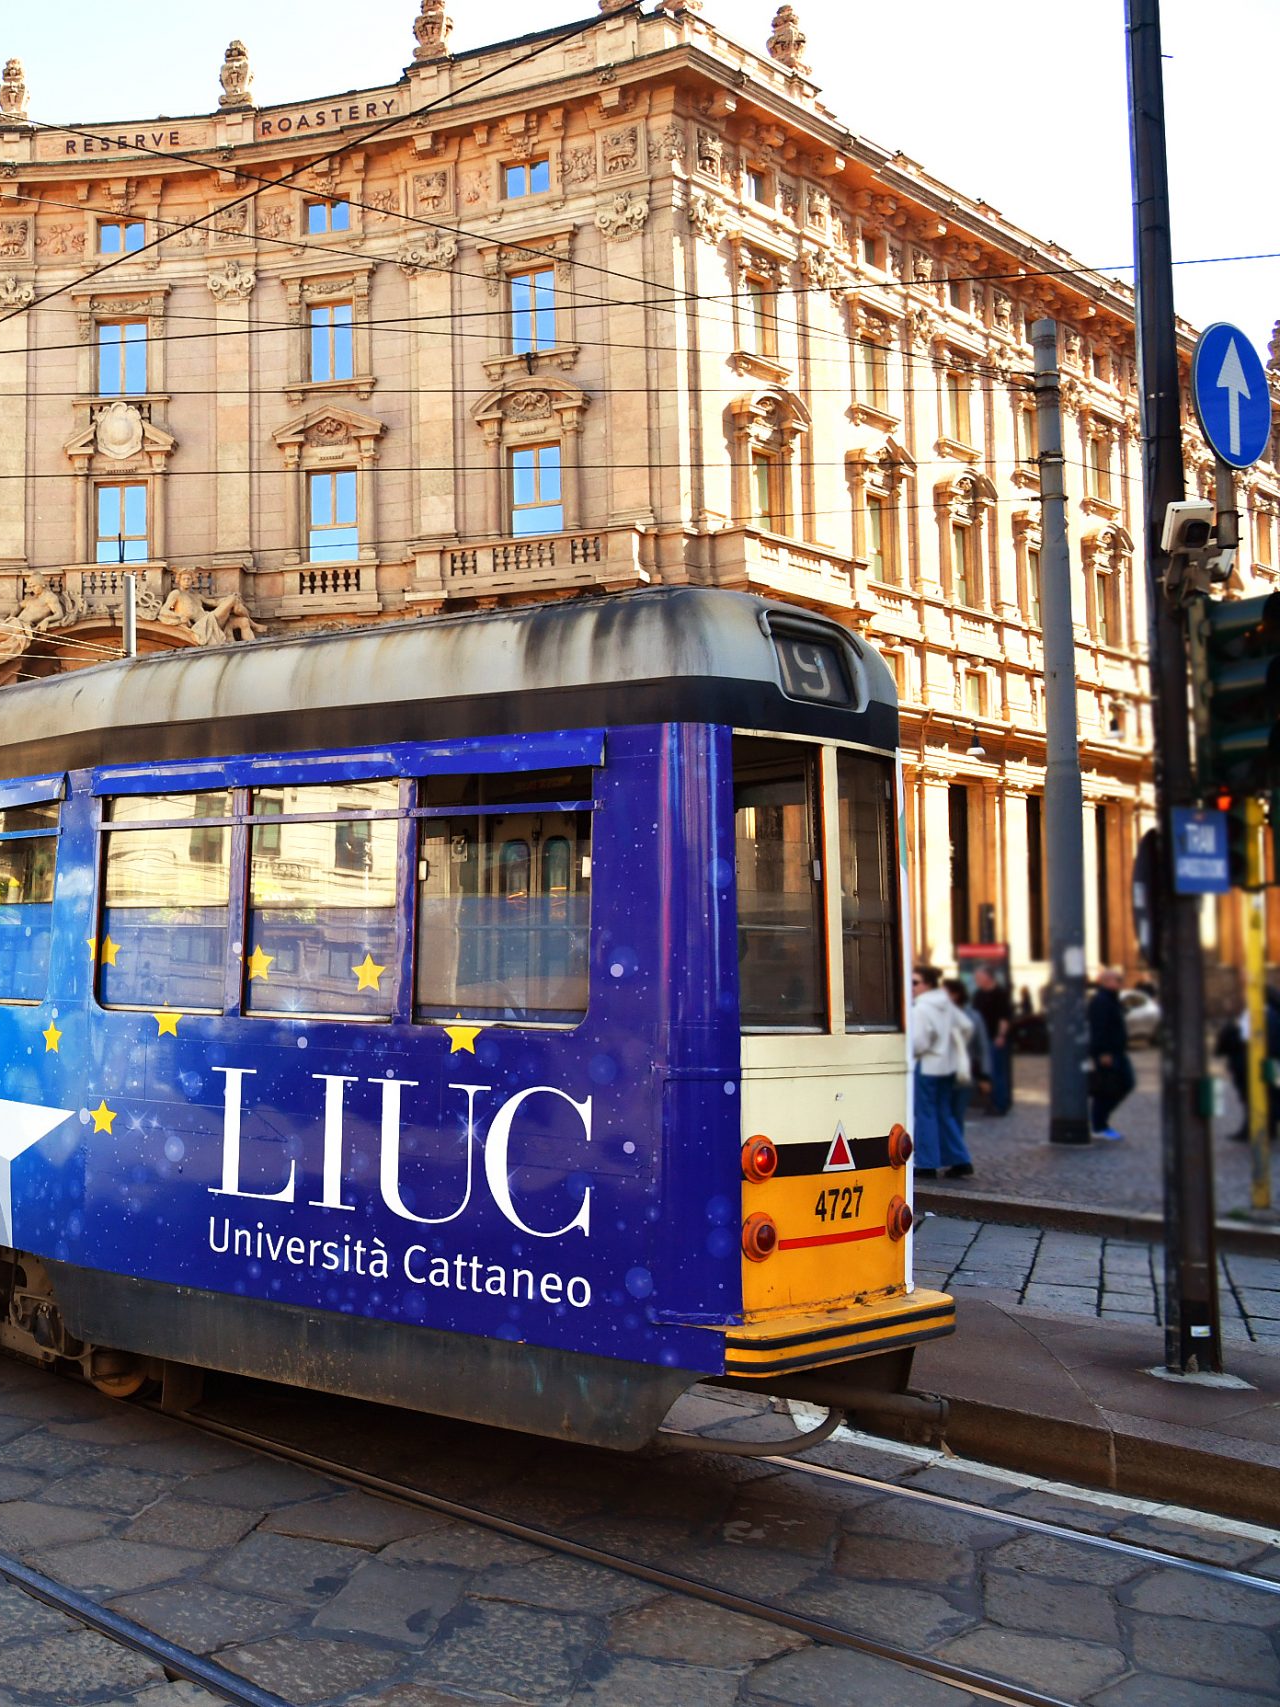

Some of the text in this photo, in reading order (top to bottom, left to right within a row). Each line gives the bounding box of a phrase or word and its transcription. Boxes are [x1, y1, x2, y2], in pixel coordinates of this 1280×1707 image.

[65, 131, 180, 154] RESERVE
[261, 99, 395, 136] ROASTERY
[775, 640, 832, 698] 19
[207, 1066, 592, 1238] LIUC
[814, 1185, 864, 1222] 4727
[207, 1216, 592, 1309] Università Cattaneo
